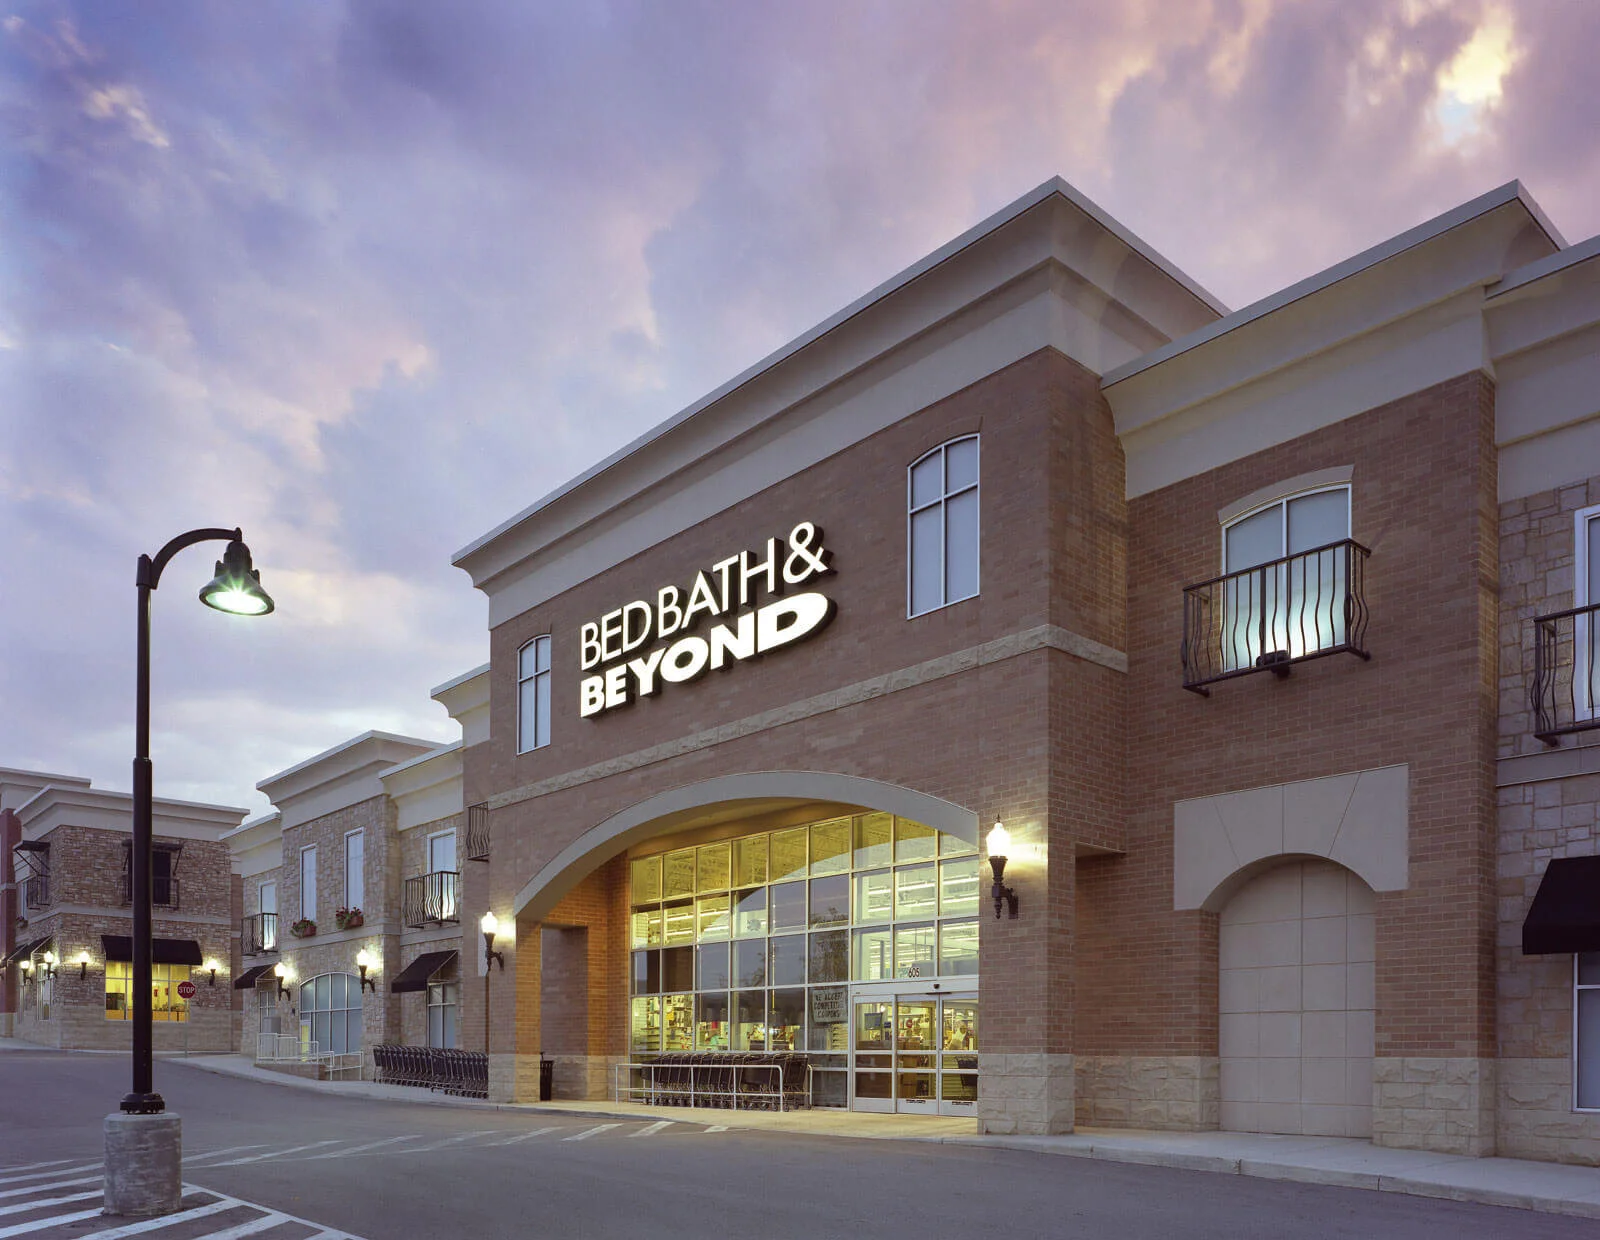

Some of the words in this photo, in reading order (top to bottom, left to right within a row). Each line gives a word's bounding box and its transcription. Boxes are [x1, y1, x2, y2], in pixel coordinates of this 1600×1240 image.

[580, 592, 829, 718] BEYOND
[581, 600, 651, 671] BED
[658, 536, 775, 638] BATH
[782, 521, 829, 584] &
